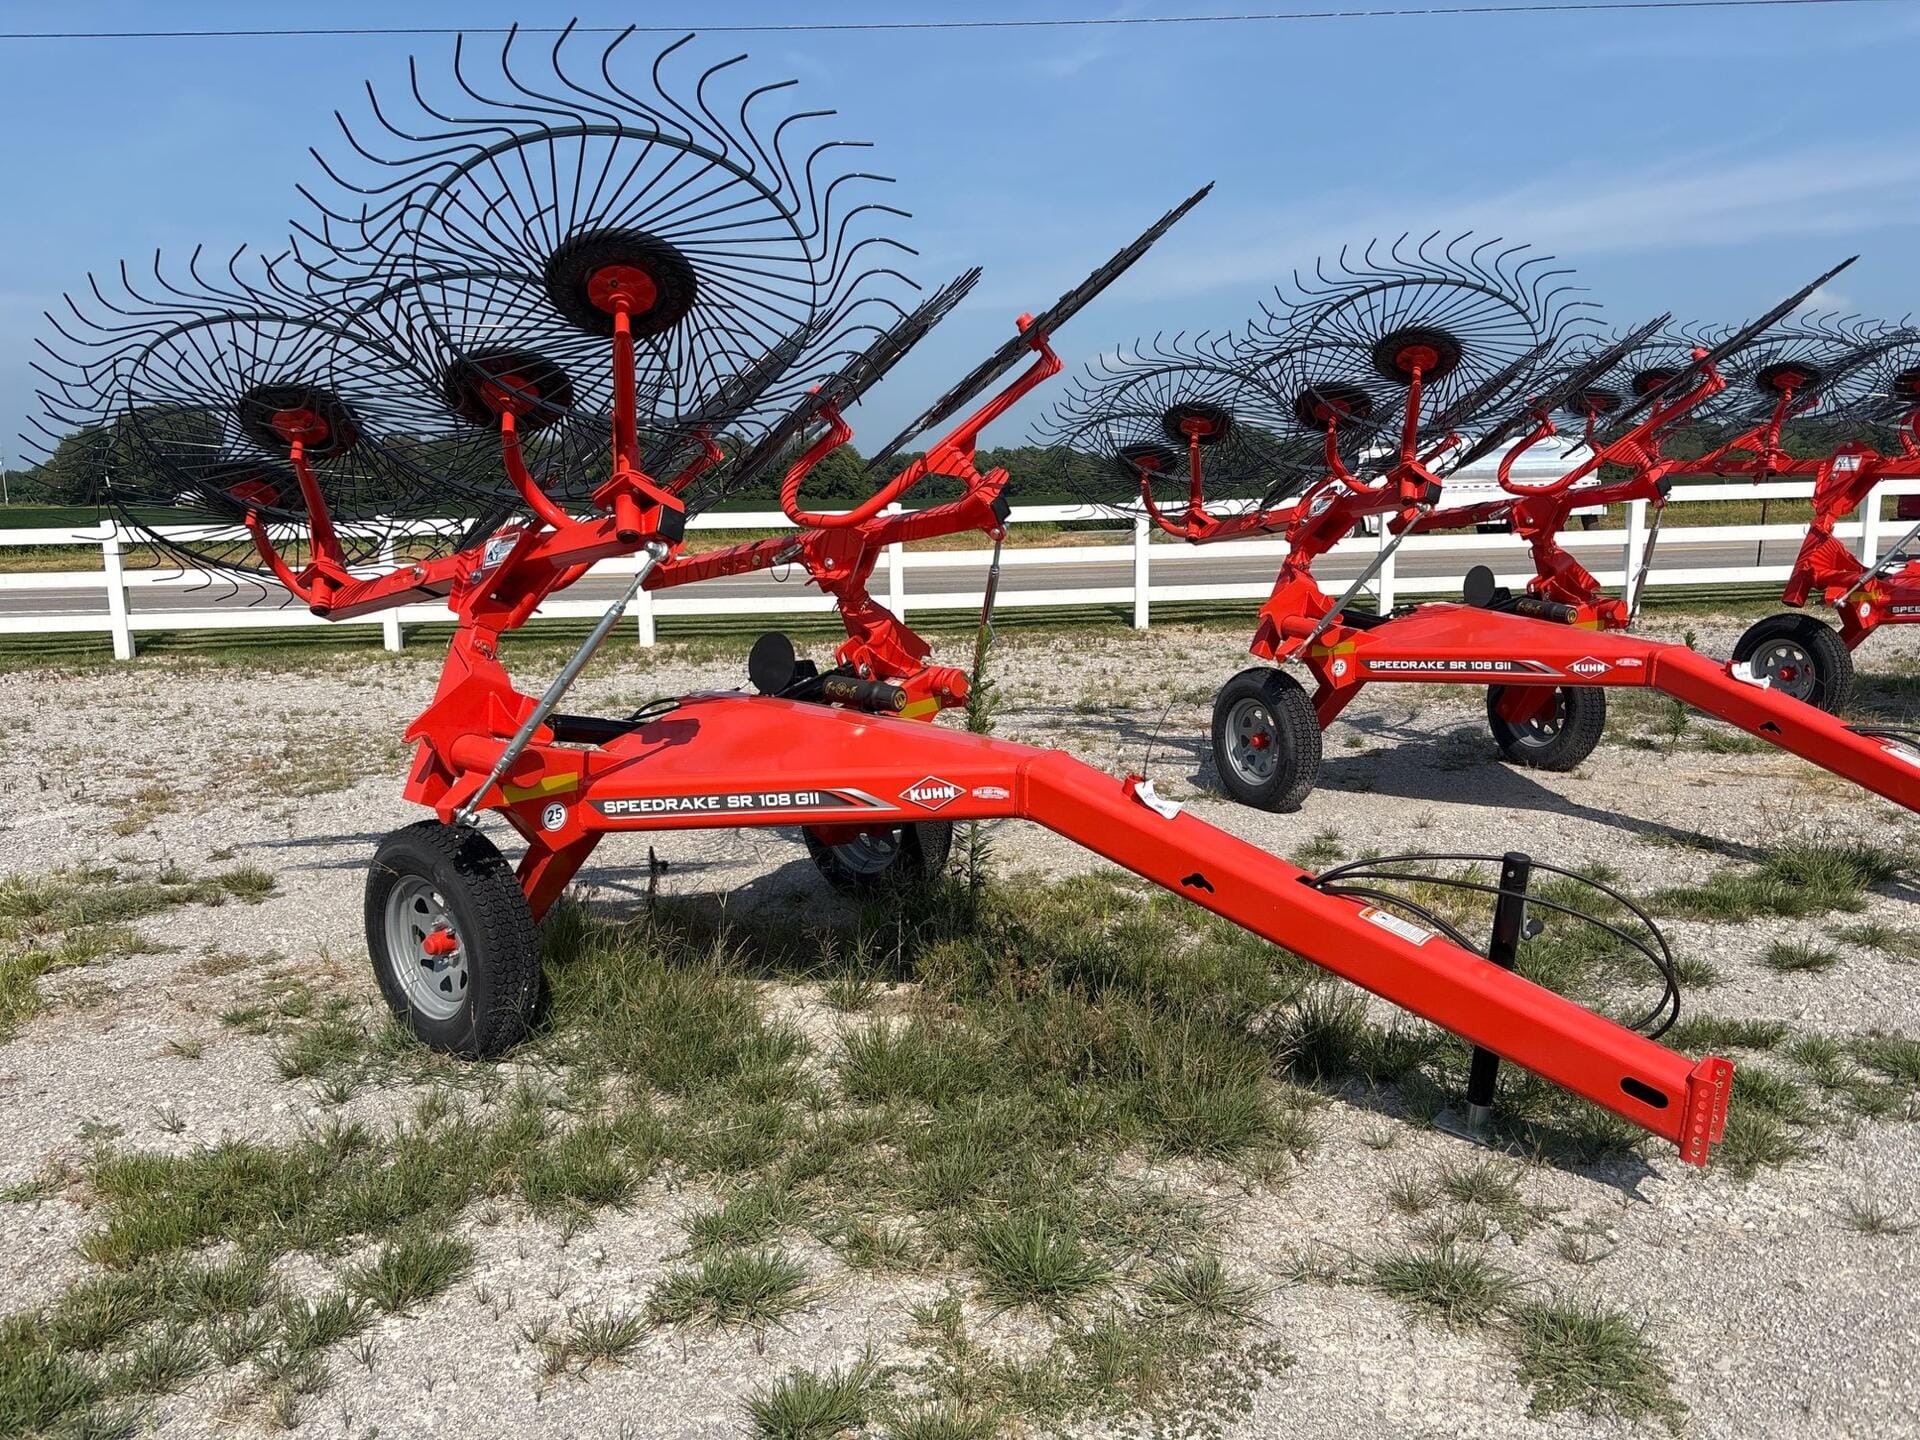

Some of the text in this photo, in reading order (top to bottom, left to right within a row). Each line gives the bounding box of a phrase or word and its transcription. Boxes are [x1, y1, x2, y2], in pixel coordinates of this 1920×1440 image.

[1369, 660, 1511, 670] SPEEDRAKE SR 108 GII
[1573, 663, 1605, 672] KUHN
[910, 786, 955, 801] KUHN
[604, 792, 820, 813] SPEEDRAKE SR 108 GII
[547, 807, 563, 823] 25
